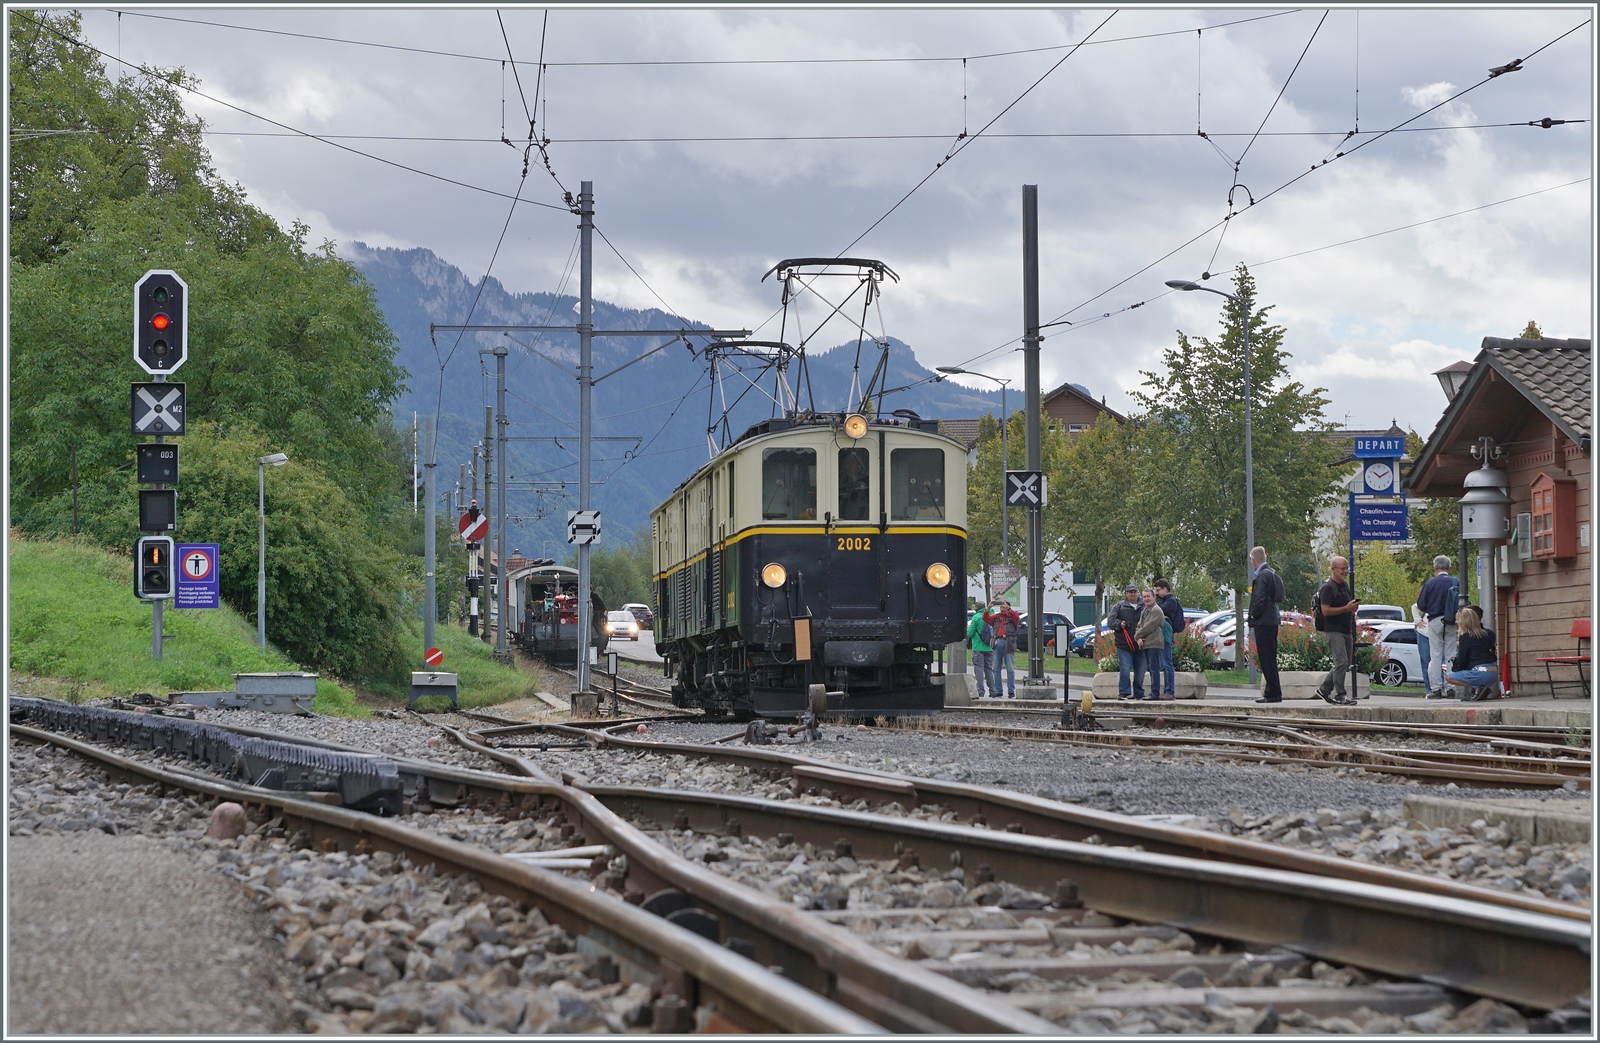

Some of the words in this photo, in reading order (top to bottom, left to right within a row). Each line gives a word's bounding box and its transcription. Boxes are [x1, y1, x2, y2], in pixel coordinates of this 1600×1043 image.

[158, 360, 163, 368] C
[172, 405, 183, 413] M2
[1357, 440, 1400, 450] DEPART
[1372, 519, 1397, 527] Chamby
[837, 537, 871, 551] 2002
